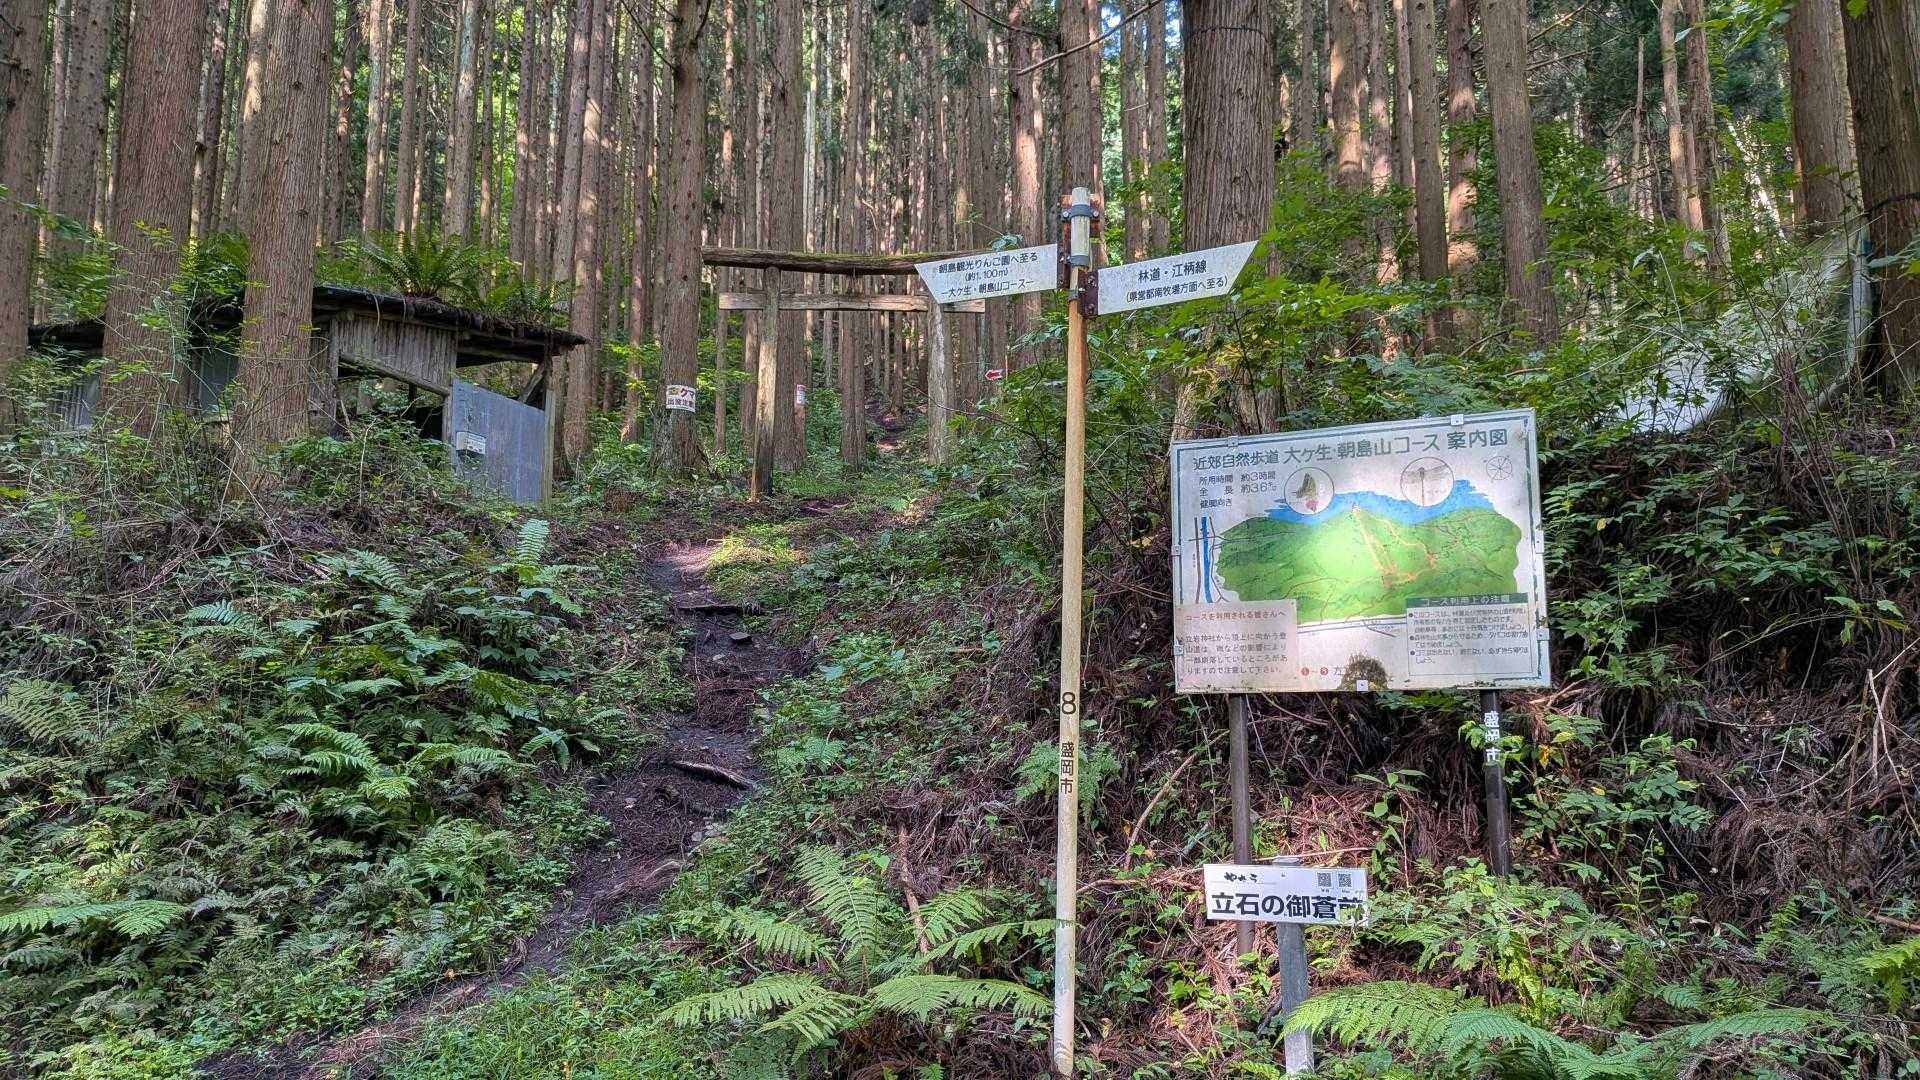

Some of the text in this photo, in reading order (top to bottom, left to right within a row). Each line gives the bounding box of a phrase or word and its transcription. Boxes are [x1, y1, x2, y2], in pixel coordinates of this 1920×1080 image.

[939, 252, 1038, 274] 朝島観光りんご園へ至る
[1138, 259, 1207, 283] 林道・江柄線
[1193, 449, 1279, 471] 近郊自然歩道
[1447, 428, 1508, 450] 案内図
[1062, 691, 1076, 715] 8
[1060, 741, 1075, 795] 盛岡市
